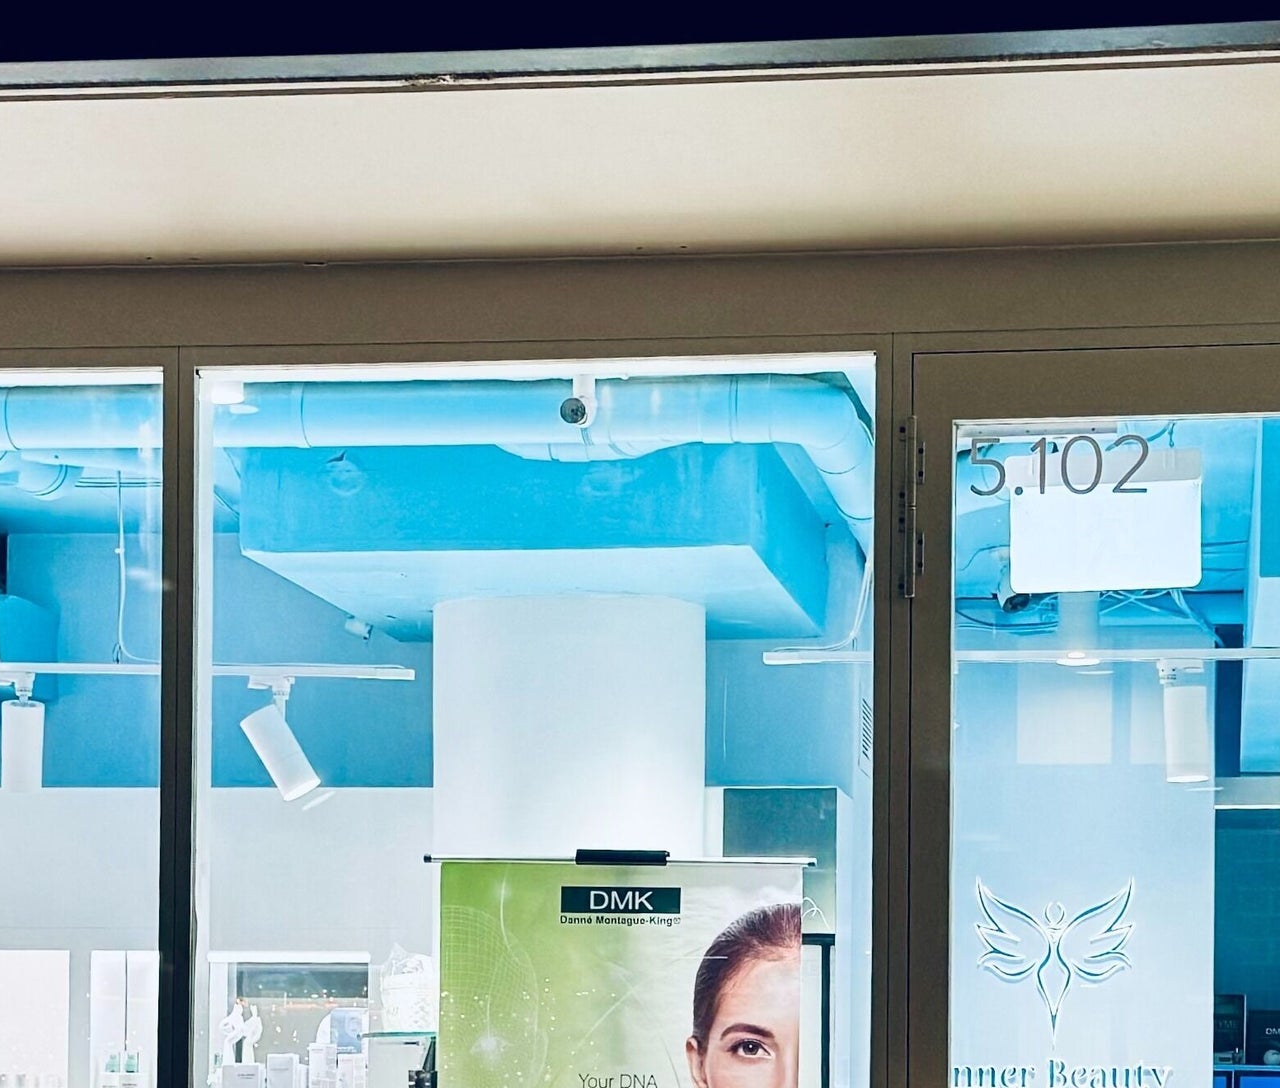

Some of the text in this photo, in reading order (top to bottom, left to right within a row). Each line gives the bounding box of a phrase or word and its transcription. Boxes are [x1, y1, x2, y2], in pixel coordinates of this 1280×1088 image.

[970, 435, 1149, 496] 5.102
[589, 890, 653, 910] DMK
[578, 1073, 658, 1088] Your DNA
